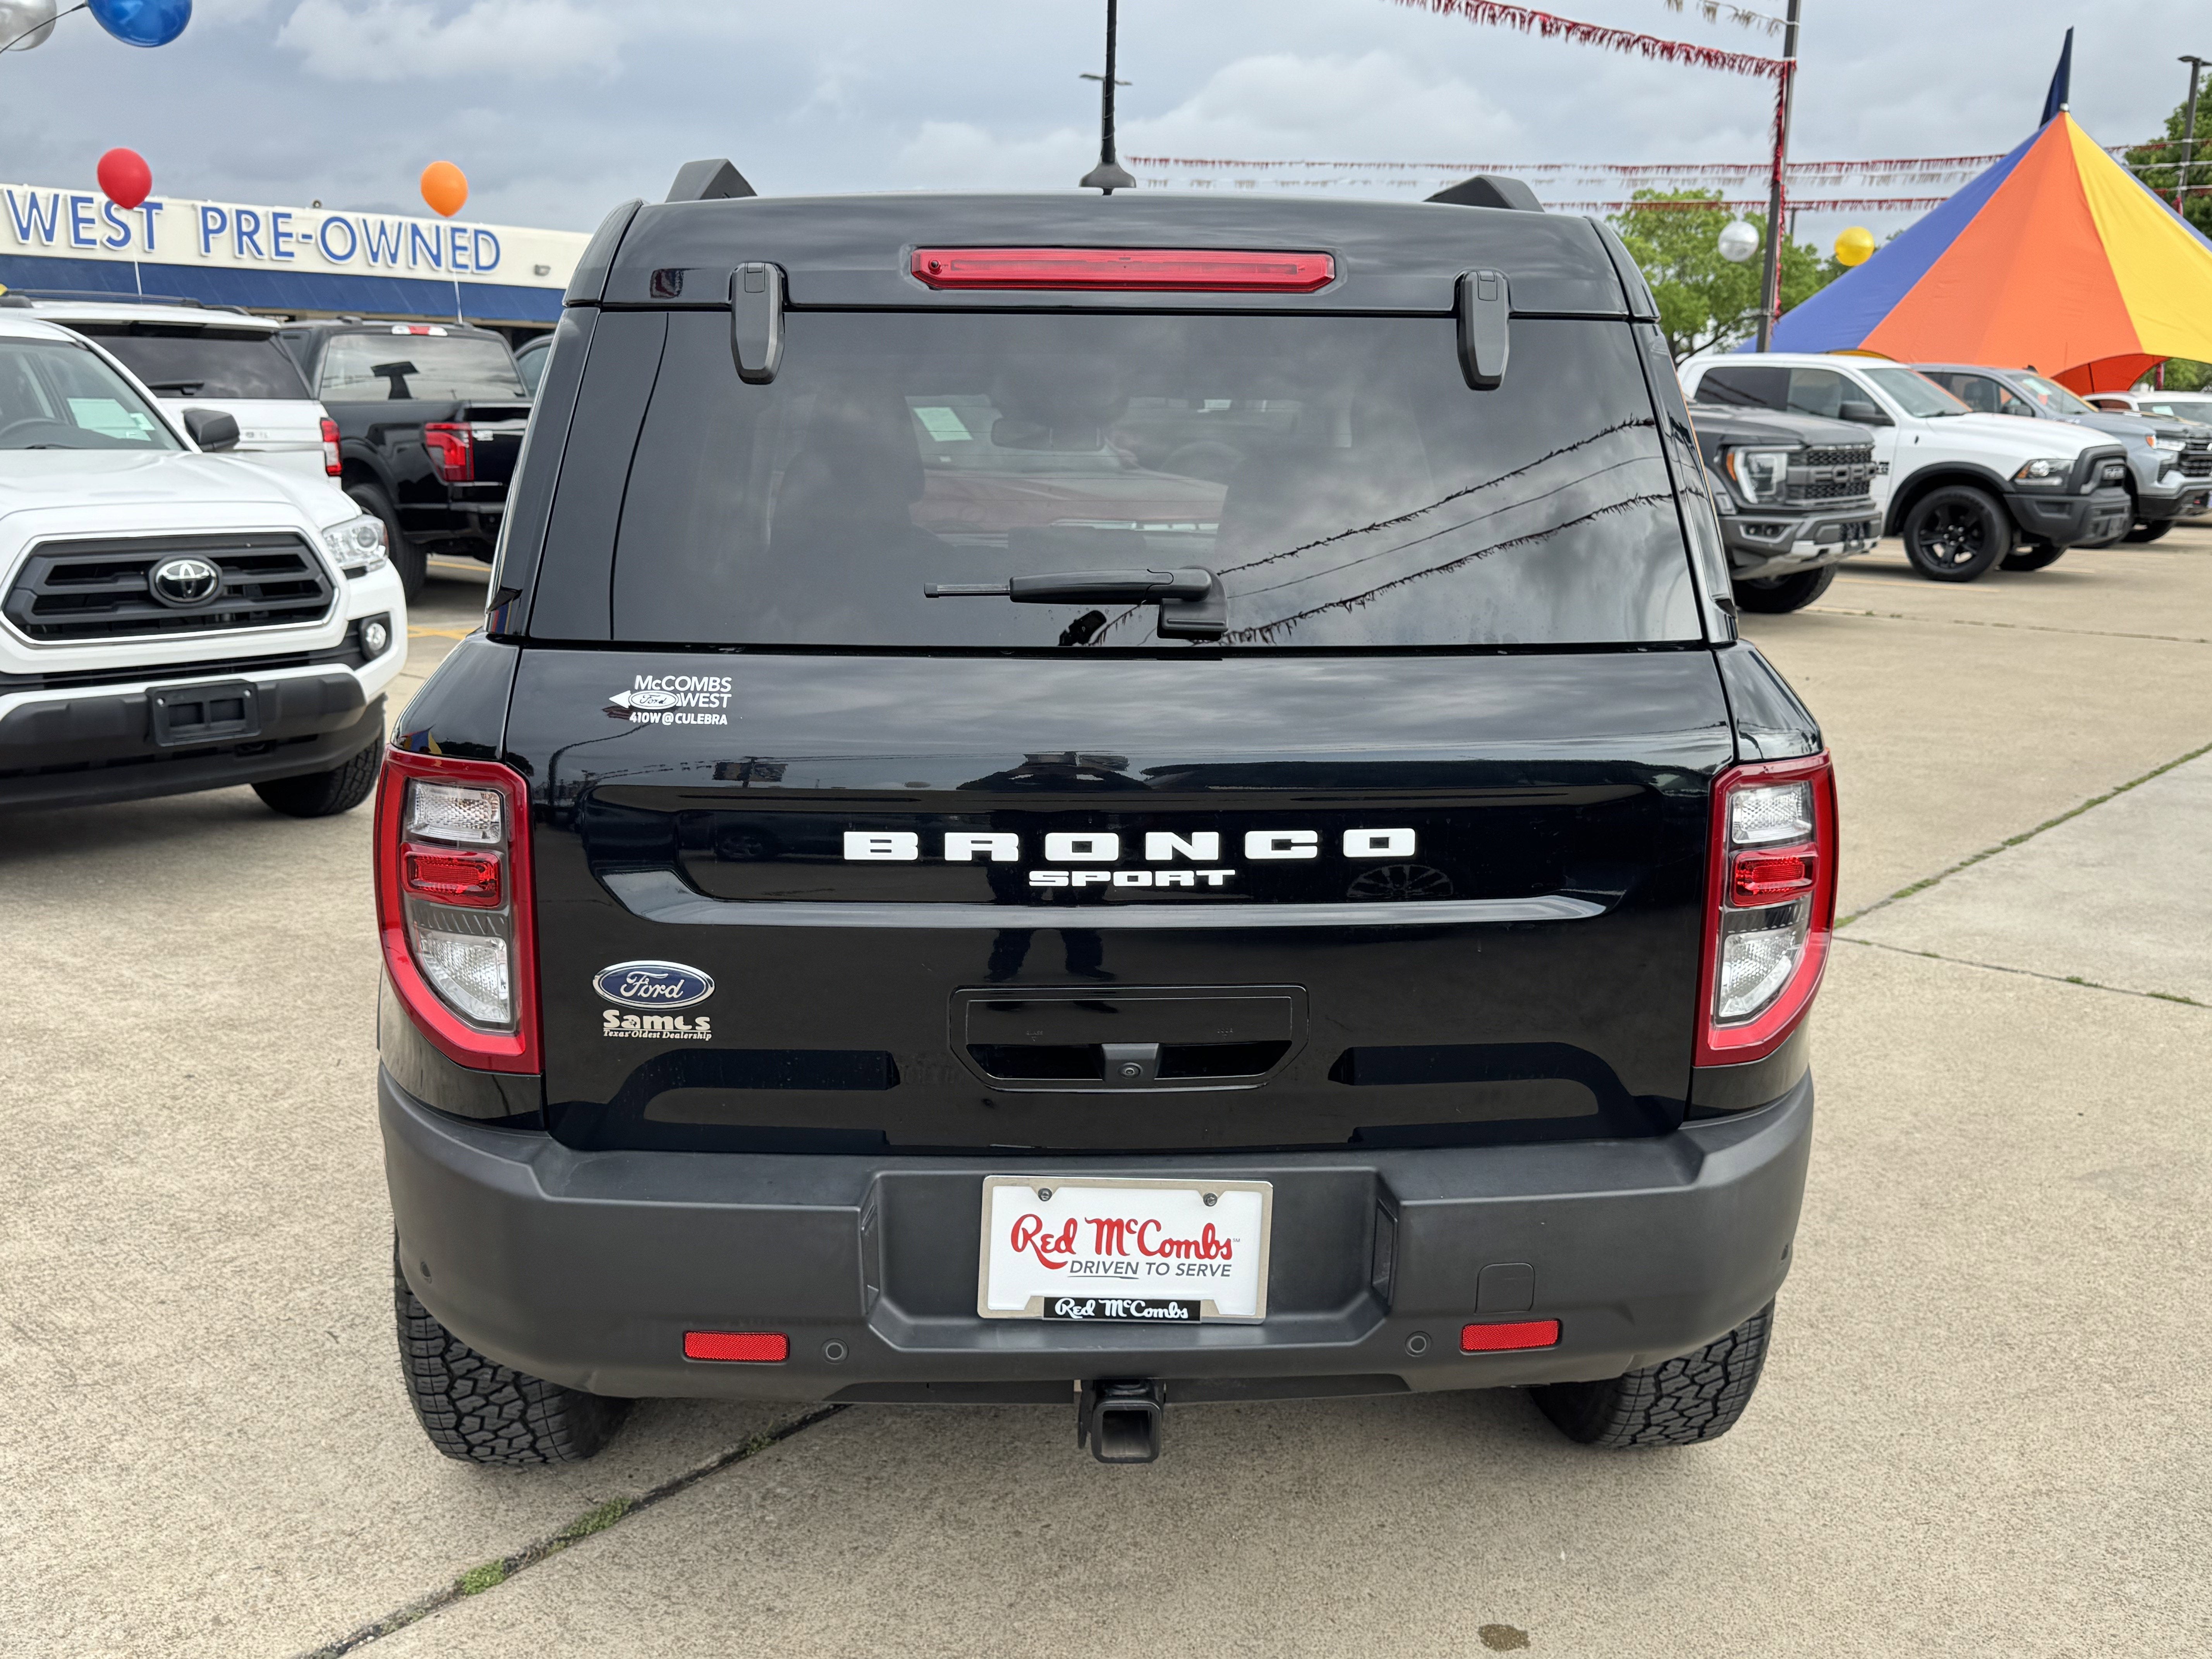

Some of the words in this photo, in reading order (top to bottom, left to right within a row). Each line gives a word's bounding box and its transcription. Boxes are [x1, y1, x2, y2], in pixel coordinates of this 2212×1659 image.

[5, 189, 164, 252] WEST
[199, 205, 501, 272] PRE-OWNED
[1810, 462, 1877, 483] FORD
[634, 675, 732, 692] McCOMBS
[640, 694, 667, 704] Ford
[680, 692, 732, 708] WEST
[843, 828, 1416, 861] BRONCO
[1029, 869, 1236, 887] SPORT
[620, 971, 685, 998] Ford
[631, 1030, 660, 1038] Oldest
[662, 1031, 712, 1041] Dealership
[1011, 1214, 1077, 1269] Red
[1085, 1216, 1233, 1260] McCombs
[1070, 1261, 1139, 1275] DRIVEN
[1146, 1262, 1170, 1276] TO
[1175, 1263, 1232, 1278] SERVE
[1055, 1297, 1096, 1319] Red
[1099, 1298, 1189, 1319] McCombs
